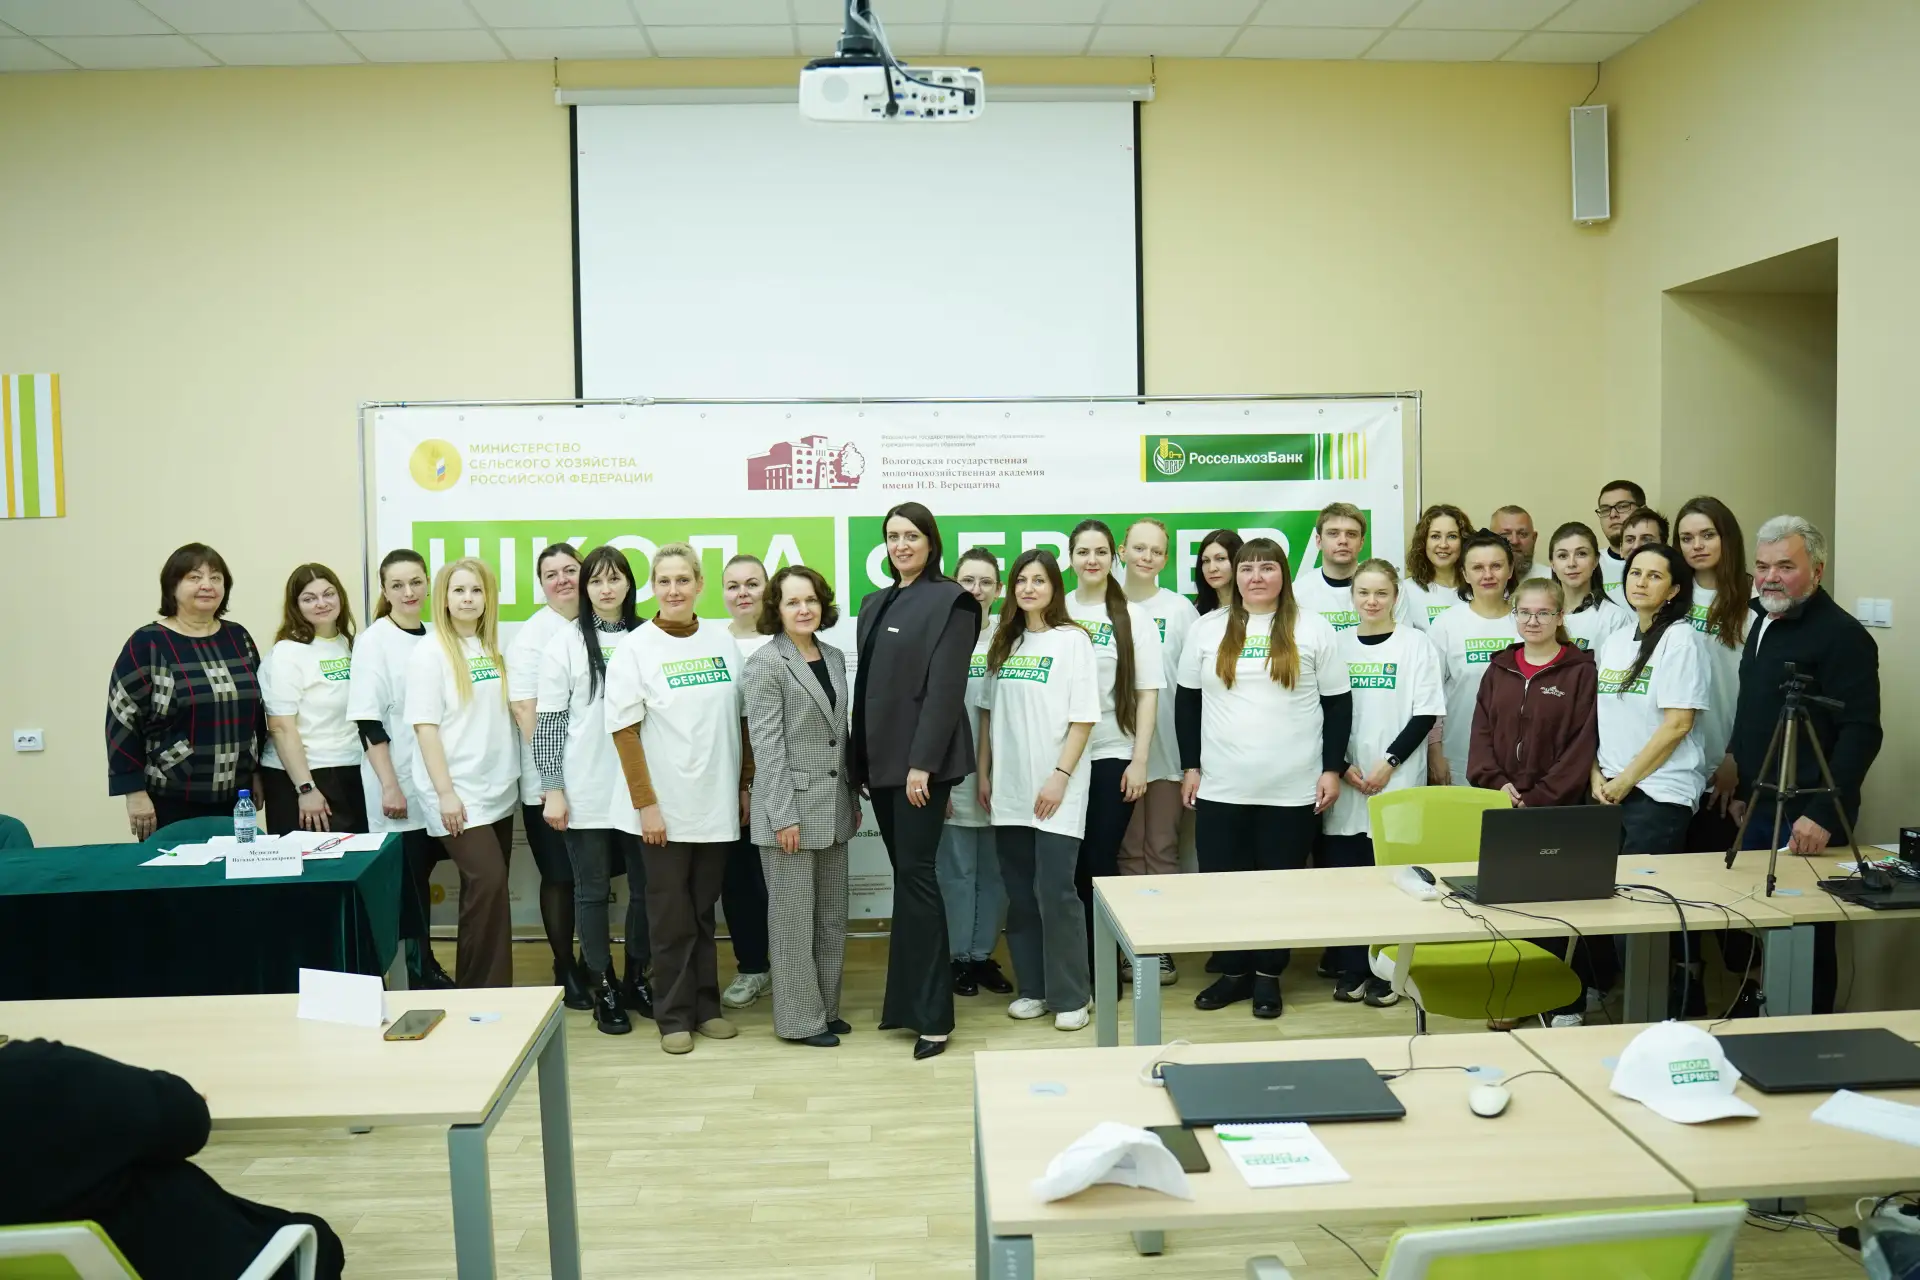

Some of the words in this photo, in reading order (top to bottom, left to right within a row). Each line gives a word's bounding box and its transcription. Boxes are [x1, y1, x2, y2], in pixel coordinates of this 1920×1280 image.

[469, 443, 581, 453] МИНИСТЕРСТВО
[469, 458, 551, 469] СЕЛЬСКОГО
[555, 456, 637, 468] ХОЗЯЙСТВА
[882, 457, 944, 466] Вологодская
[946, 457, 1028, 467] государственная
[1189, 451, 1303, 464] РоссельхозБанк
[470, 472, 565, 485] РОССИЙСКОЙ
[569, 472, 653, 485] ФЕДЕРАЦИИ
[882, 468, 996, 477] молочнохозяйственная
[998, 469, 1045, 477] академия
[940, 480, 1000, 491] Верещагина
[664, 659, 713, 673] ШКОЛА
[670, 671, 730, 686] ФЕРМЕРА
